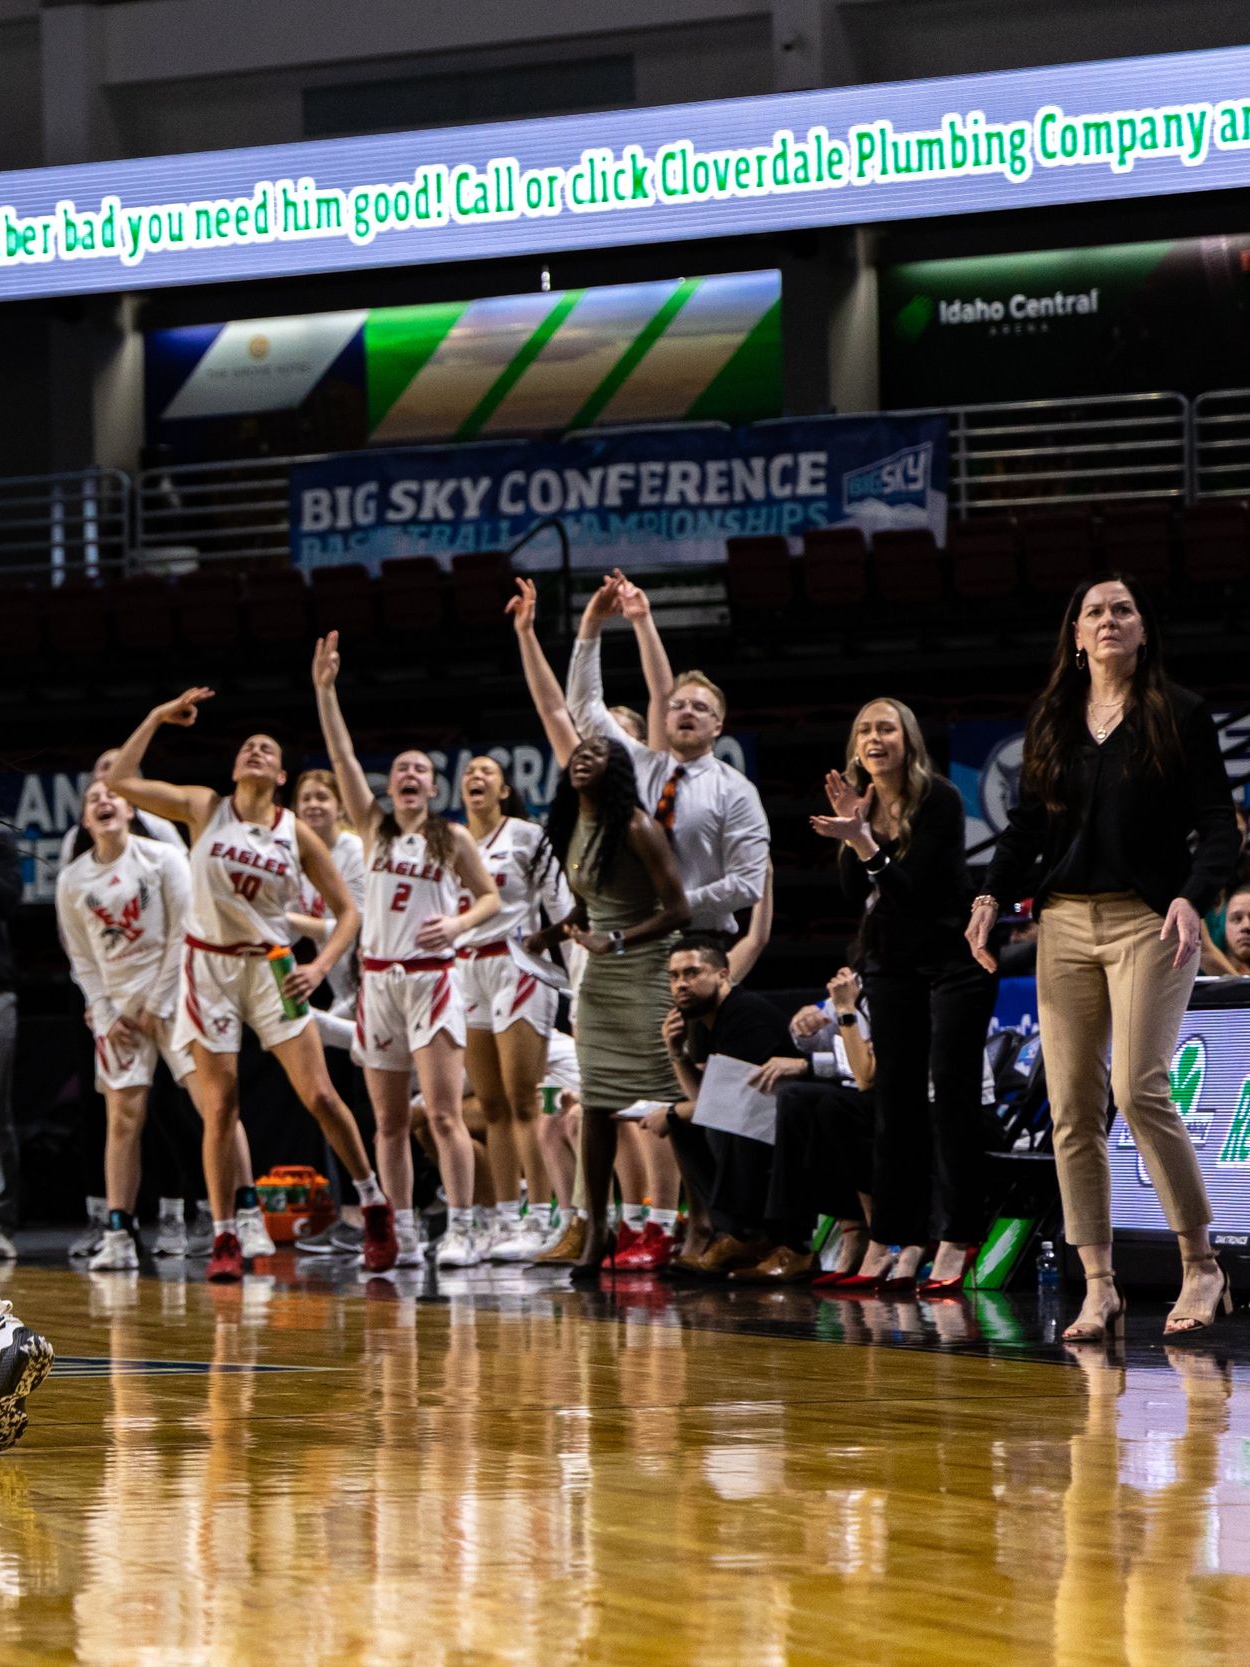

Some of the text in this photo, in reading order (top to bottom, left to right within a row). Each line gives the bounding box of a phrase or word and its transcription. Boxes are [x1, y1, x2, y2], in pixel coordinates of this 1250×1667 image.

[61, 202, 117, 254] bad
[126, 207, 185, 260] you
[193, 186, 270, 242] need
[280, 183, 343, 234] him
[352, 170, 446, 240] good!
[453, 163, 517, 218] Call
[524, 172, 561, 211] or
[569, 151, 651, 207] click
[659, 133, 846, 199] Cloverdale
[854, 117, 1028, 179] Plumbing
[1038, 109, 1209, 168] Company
[938, 287, 1100, 327] Idaho Central
[300, 451, 828, 532] BIG SKY CONFERENCE
[209, 841, 288, 877] EAGLES
[370, 857, 445, 883] EAGLES
[390, 881, 413, 913] 2
